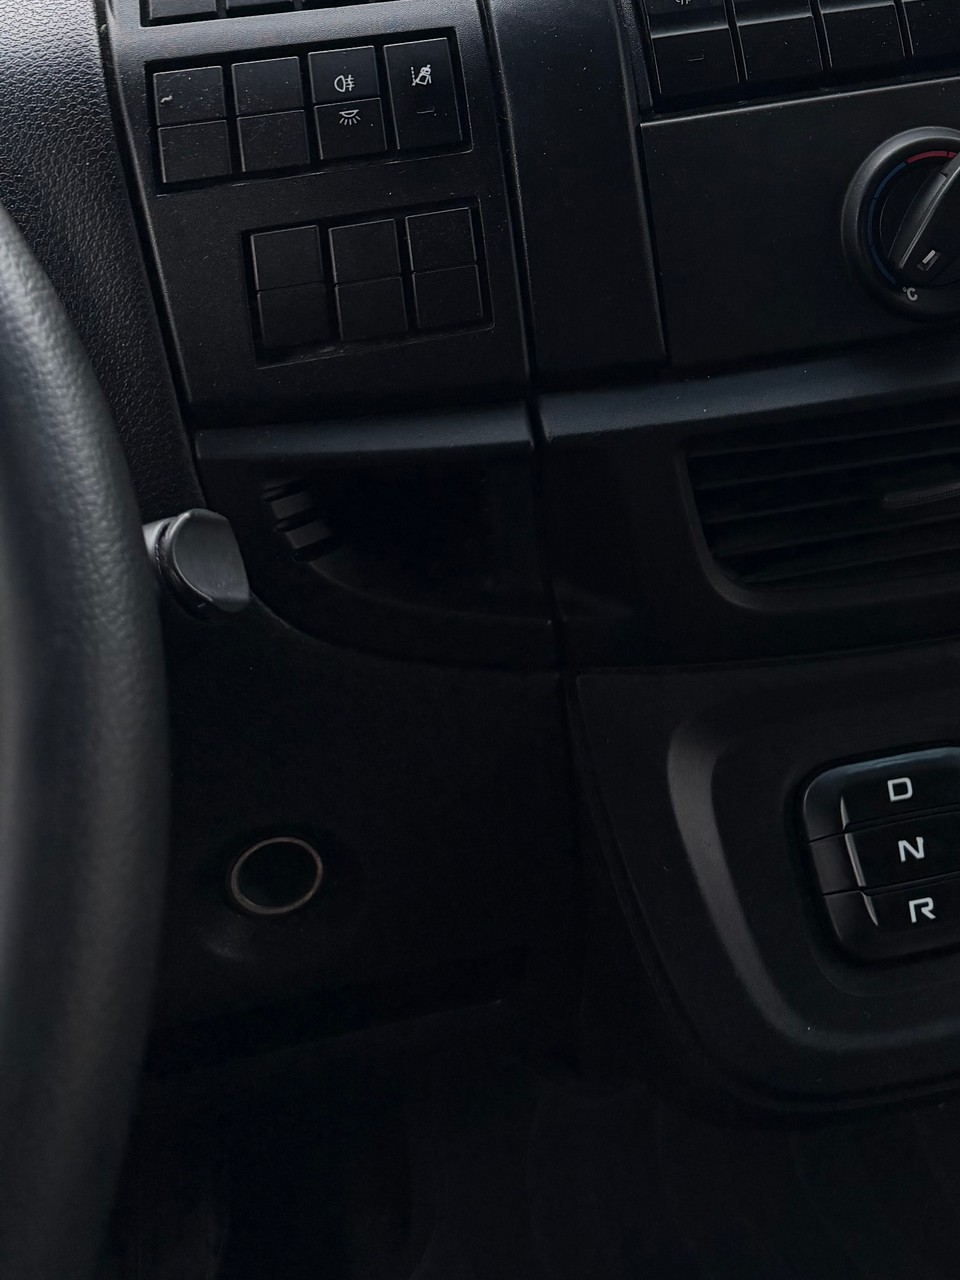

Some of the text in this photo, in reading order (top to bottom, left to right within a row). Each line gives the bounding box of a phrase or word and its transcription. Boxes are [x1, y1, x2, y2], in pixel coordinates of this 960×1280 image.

[887, 777, 913, 802] D
[897, 836, 925, 863] N
[908, 896, 936, 923] R
